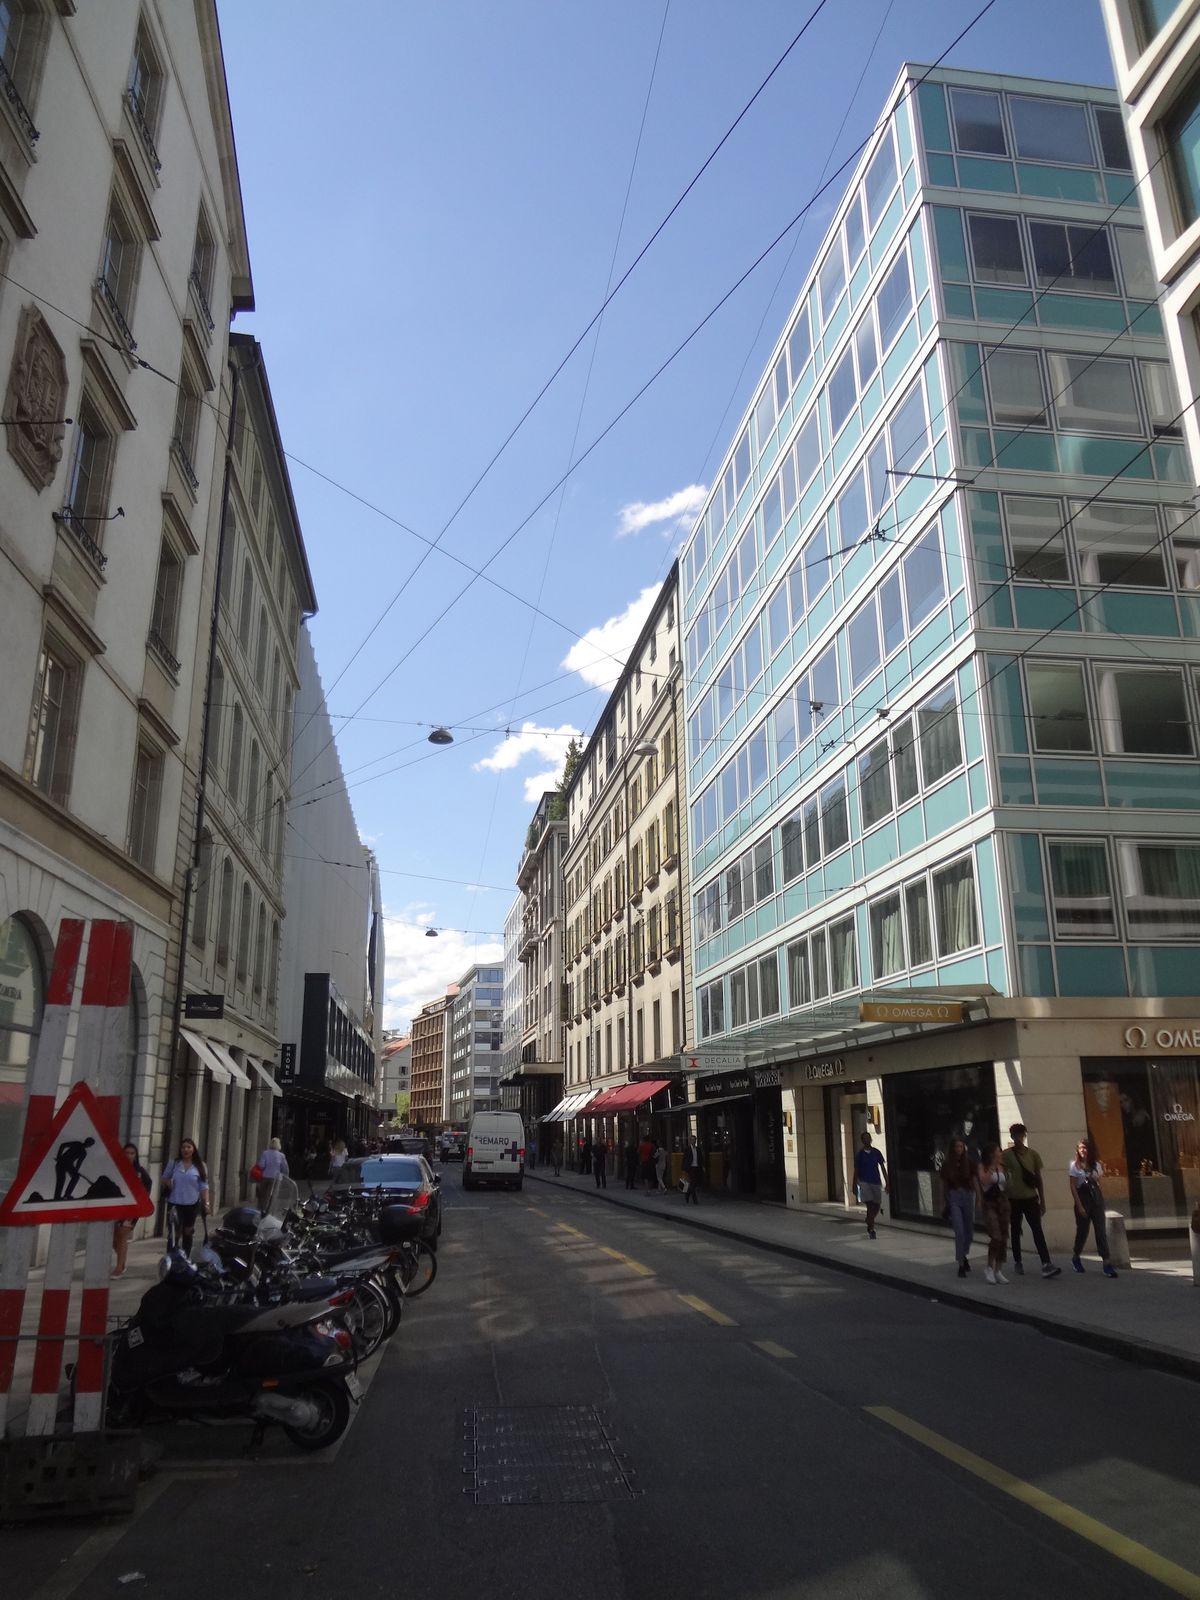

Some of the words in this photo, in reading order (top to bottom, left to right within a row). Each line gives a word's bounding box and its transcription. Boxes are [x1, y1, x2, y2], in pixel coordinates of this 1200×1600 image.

[892, 1007, 933, 1018] OMEGA
[704, 1056, 741, 1064] DECALIA
[812, 1063, 834, 1079] OMEGA
[1164, 1113, 1195, 1122] OMEGA
